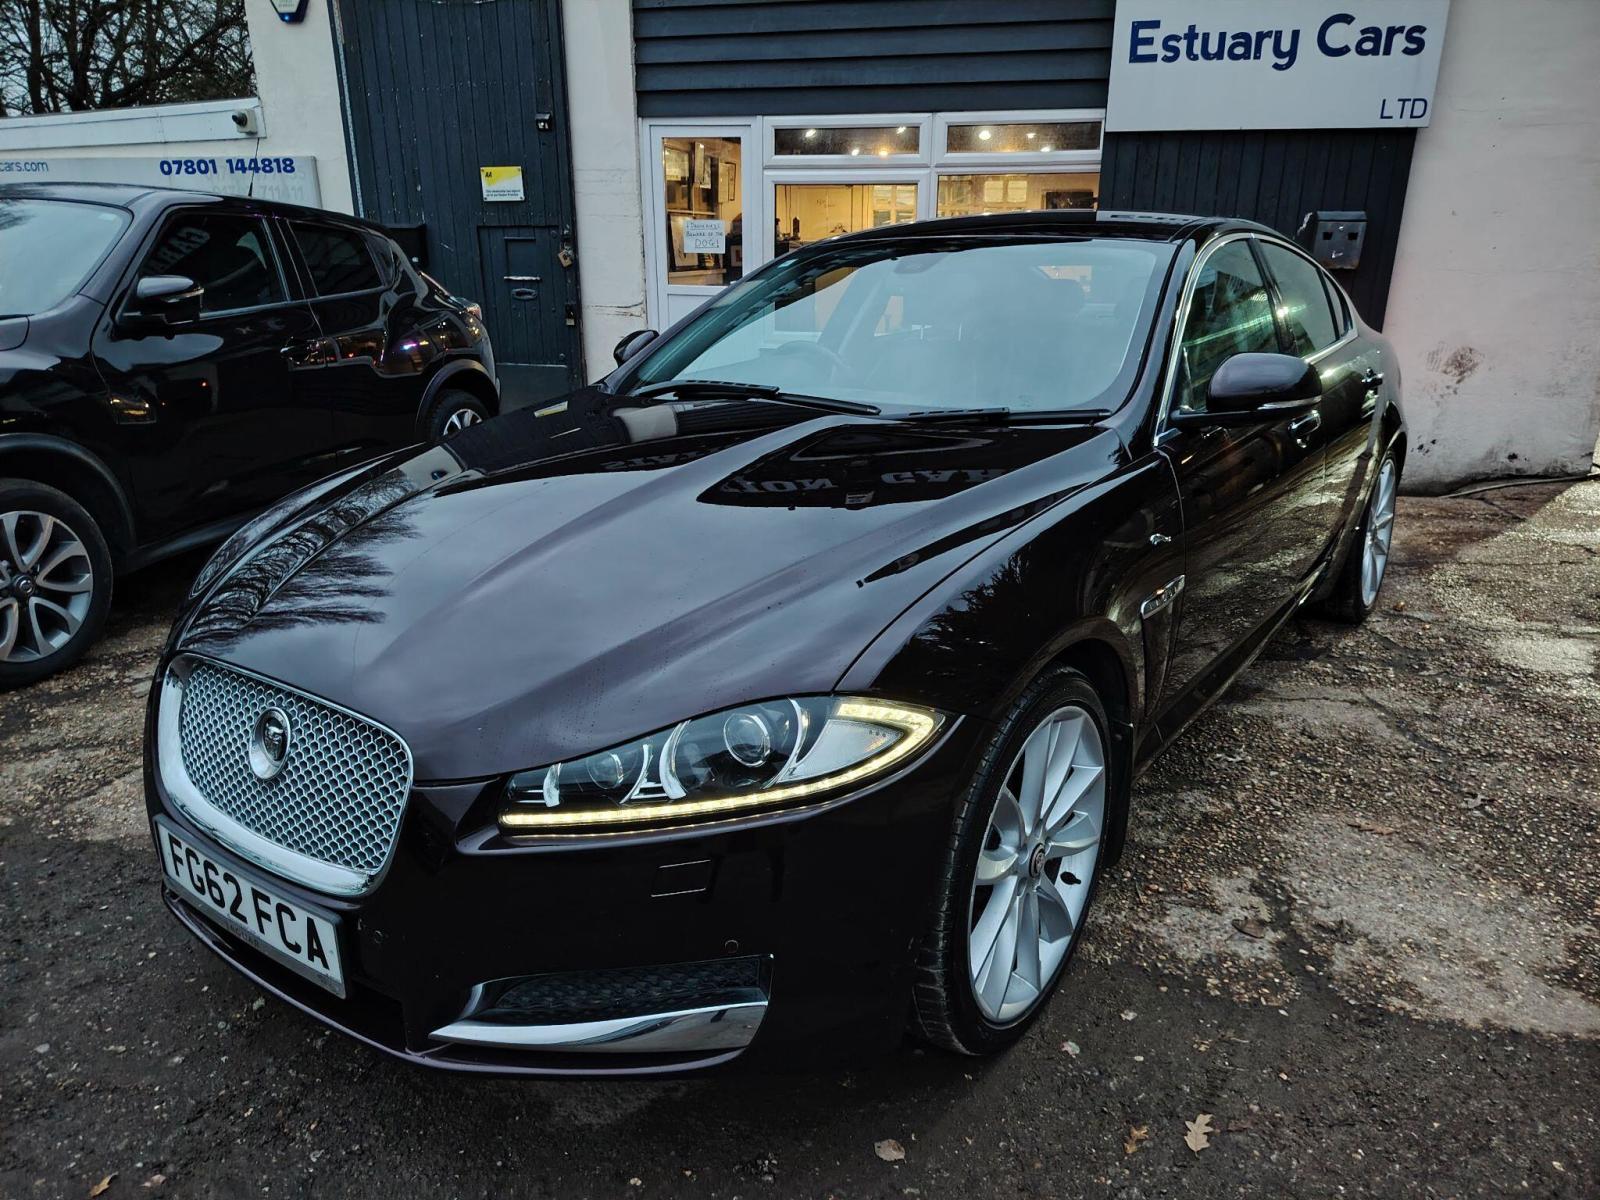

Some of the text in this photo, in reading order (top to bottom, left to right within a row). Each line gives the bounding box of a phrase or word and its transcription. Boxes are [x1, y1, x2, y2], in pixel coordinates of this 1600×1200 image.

[1129, 13, 1426, 71] Estuary Cars
[1380, 97, 1428, 120] LTD
[160, 159, 218, 176] 07801
[226, 157, 296, 174] 144818
[168, 832, 330, 970] FG62 FCA
